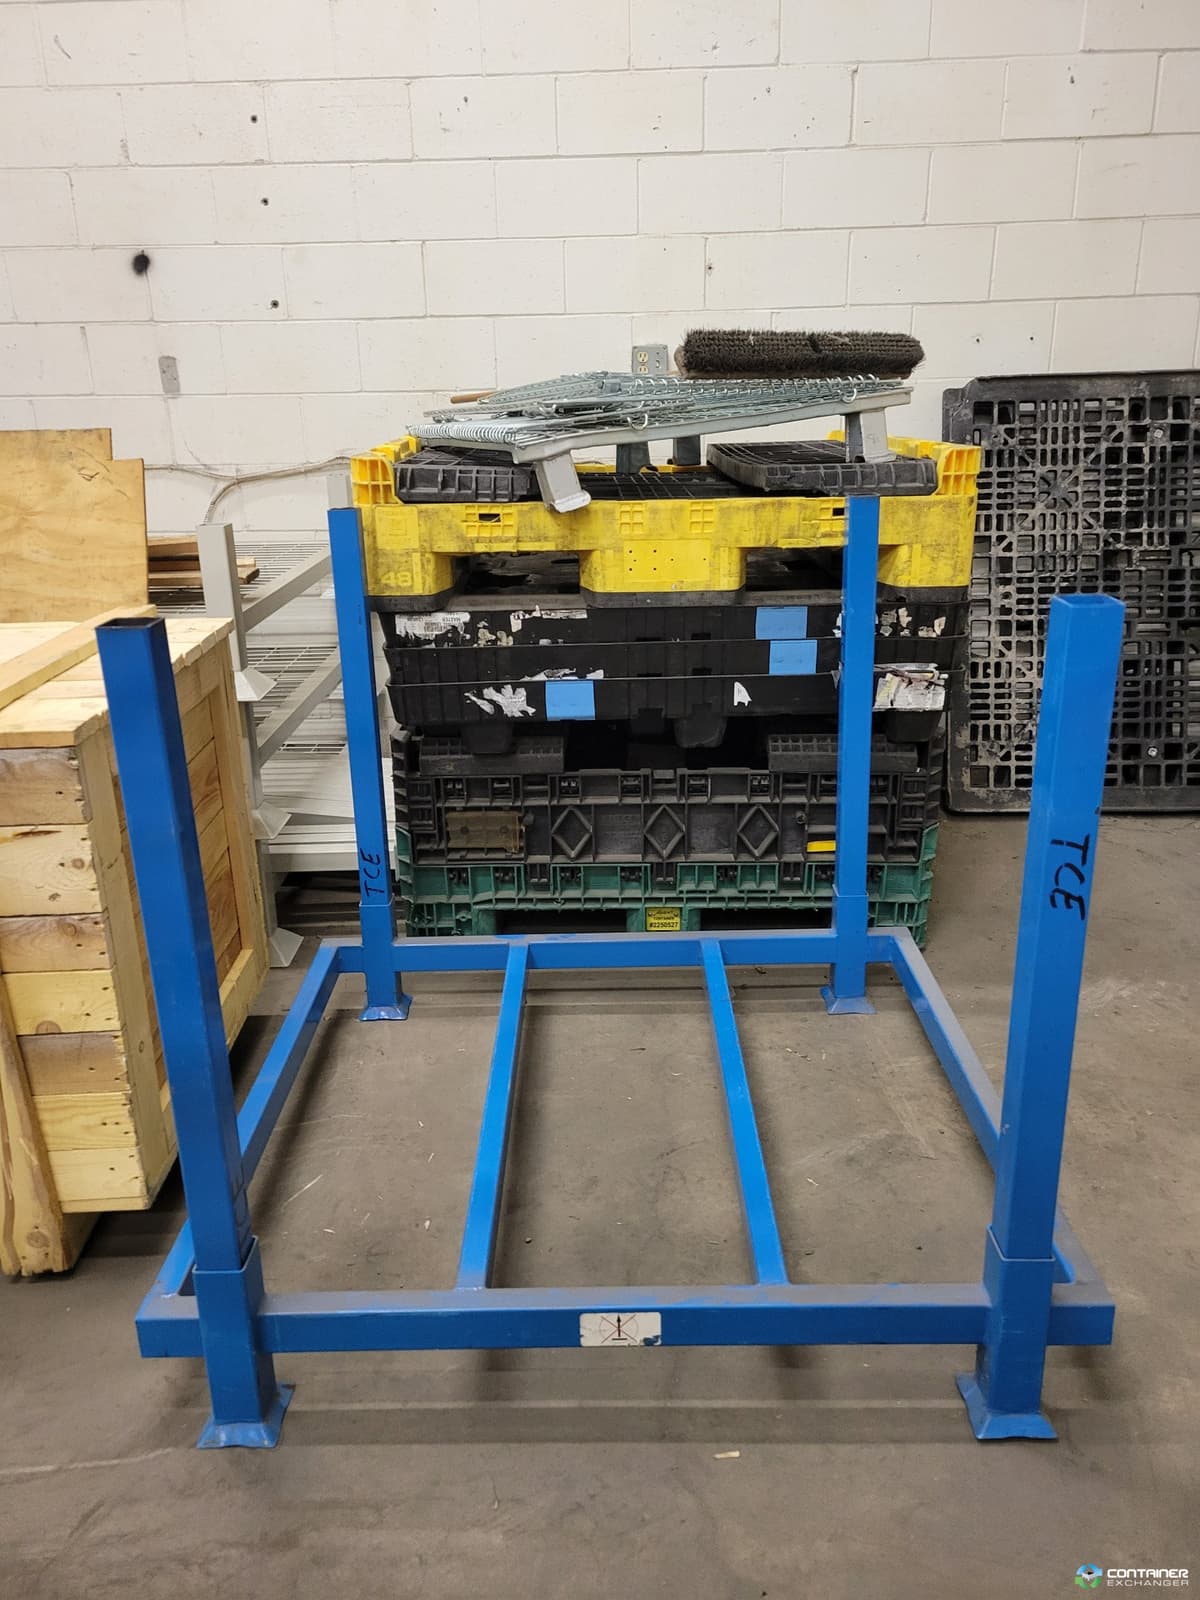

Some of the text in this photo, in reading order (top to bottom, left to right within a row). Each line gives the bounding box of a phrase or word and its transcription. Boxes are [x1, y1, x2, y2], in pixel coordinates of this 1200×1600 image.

[381, 571, 413, 587] 48
[360, 848, 385, 897] TCE
[1050, 833, 1090, 921] TCE
